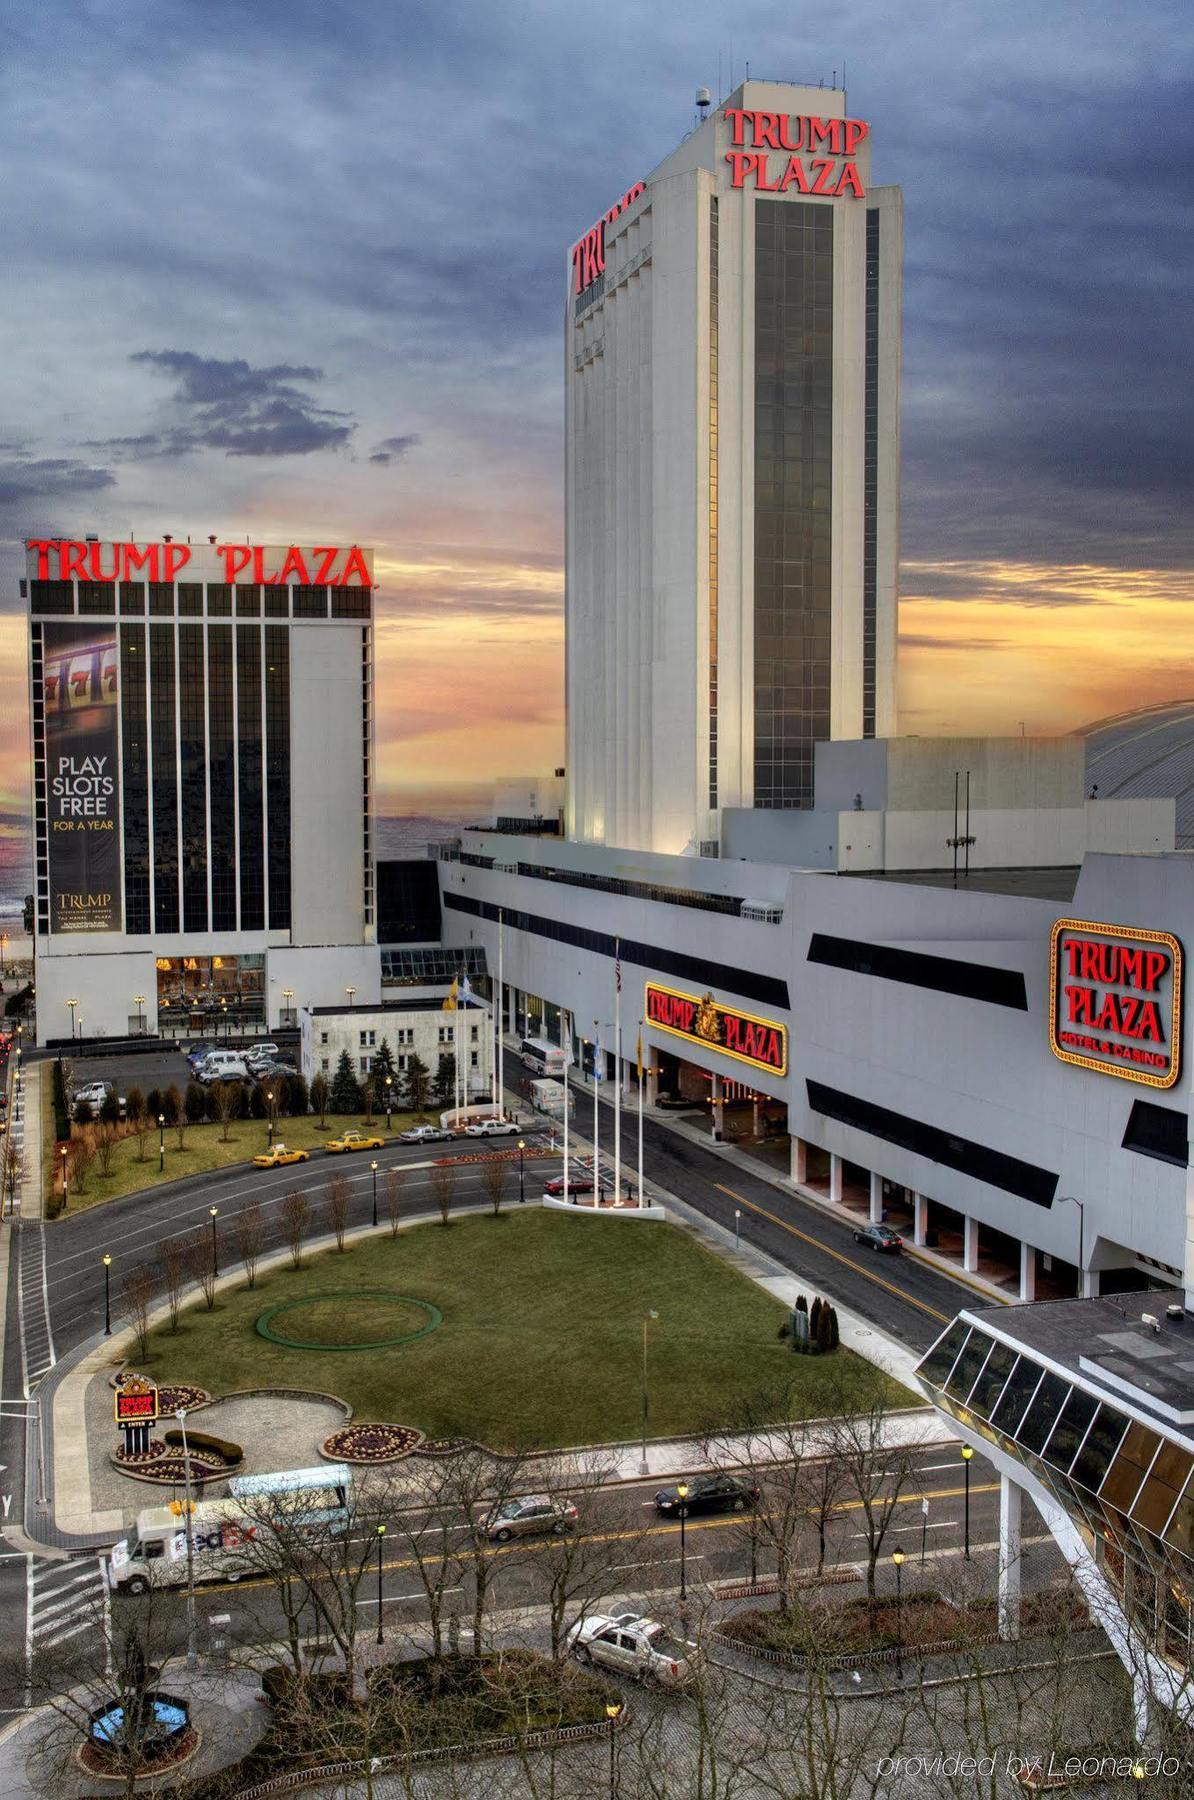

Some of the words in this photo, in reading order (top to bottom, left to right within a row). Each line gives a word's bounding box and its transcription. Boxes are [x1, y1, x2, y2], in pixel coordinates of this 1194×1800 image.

[723, 108, 870, 156] TRUMP
[724, 152, 866, 198] PLAZA
[27, 540, 192, 583] TRUMP
[216, 545, 373, 587] PLAZA
[52, 777, 114, 796] SLOTS
[59, 756, 107, 775] PLAY
[53, 821, 74, 831] FOR
[77, 821, 86, 830] A
[88, 820, 114, 830] YEAR
[60, 797, 107, 816] FREE
[56, 893, 111, 909] TRUMP
[1063, 939, 1167, 992] TRUMP
[648, 989, 695, 1032] TRUMP
[723, 1014, 781, 1066] PLAZA
[1064, 985, 1165, 1043] PLAZA
[1060, 1031, 1101, 1052] HOTEL
[1113, 1044, 1168, 1069] CASINO
